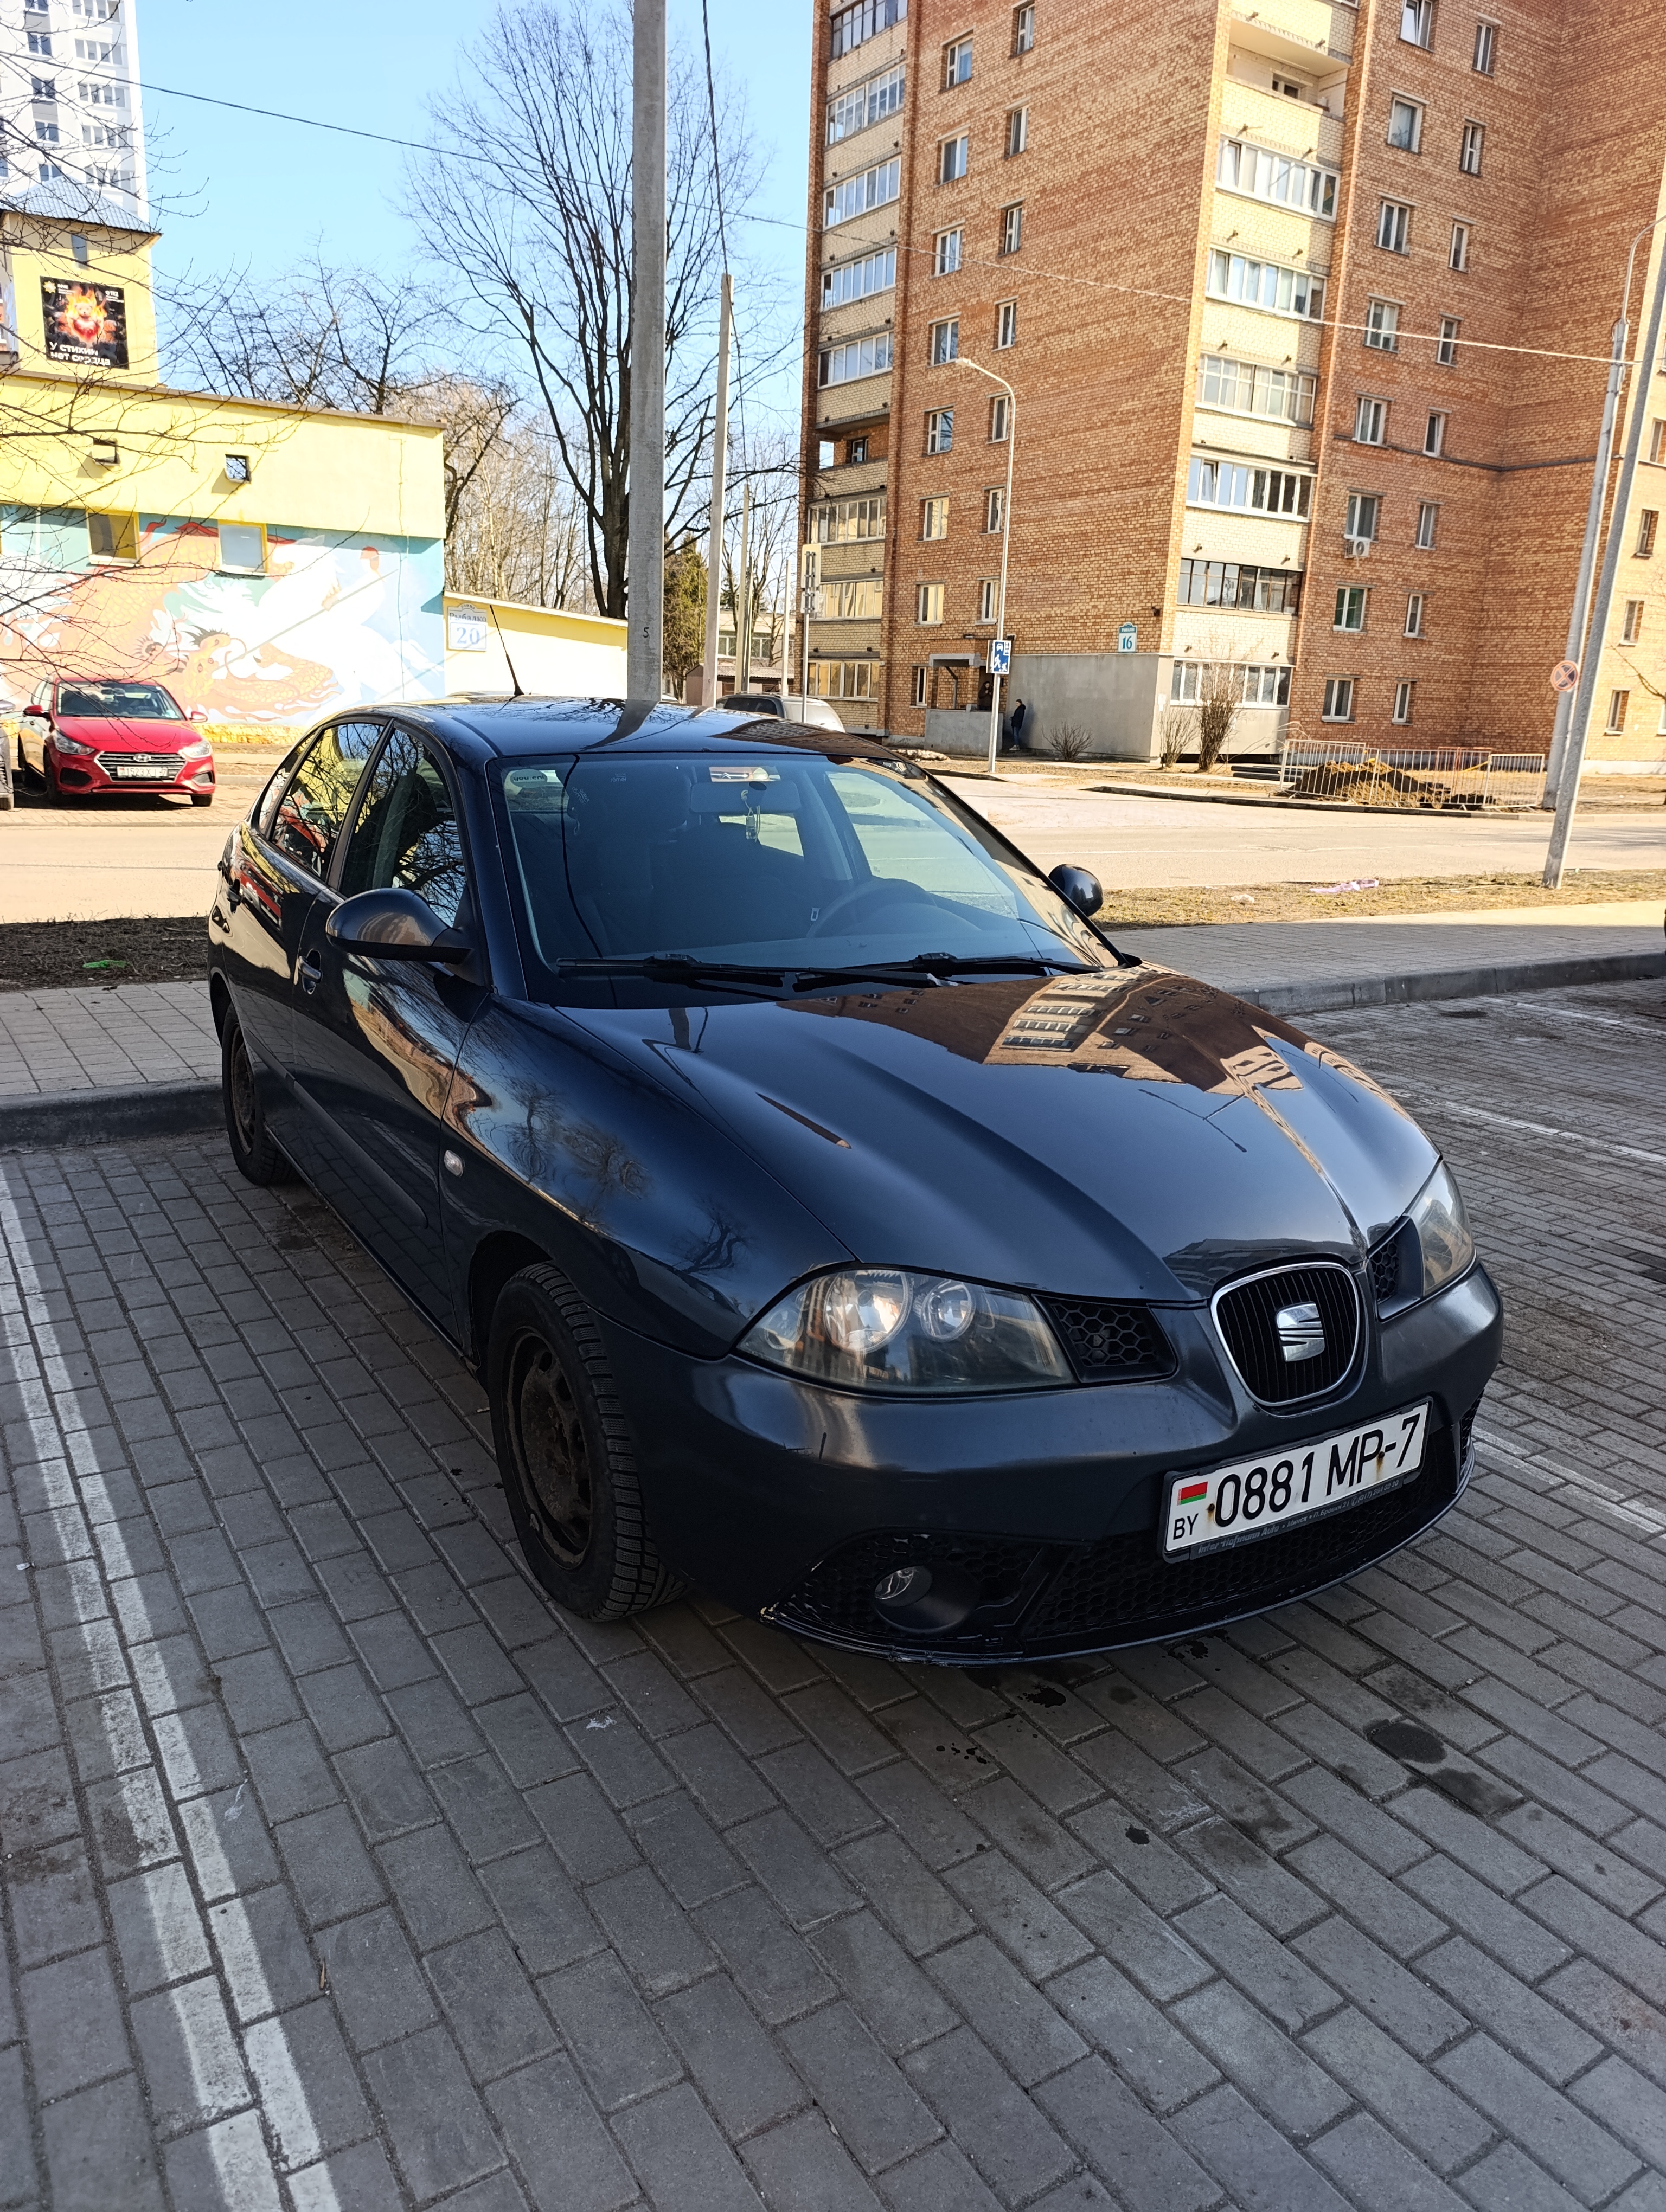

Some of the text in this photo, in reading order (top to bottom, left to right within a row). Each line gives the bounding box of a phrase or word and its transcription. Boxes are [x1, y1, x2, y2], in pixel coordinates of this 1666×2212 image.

[49, 342, 58, 350] У
[50, 352, 111, 366] нет сердца
[457, 627, 480, 645] 20
[643, 627, 650, 638] 5
[1122, 635, 1132, 650] 16
[1215, 1413, 1420, 1527] 0881 MP-7
[1261, 1525, 1280, 1536] Auto
[1342, 1500, 1350, 1508] 21
[1172, 1513, 1199, 1540] BY
